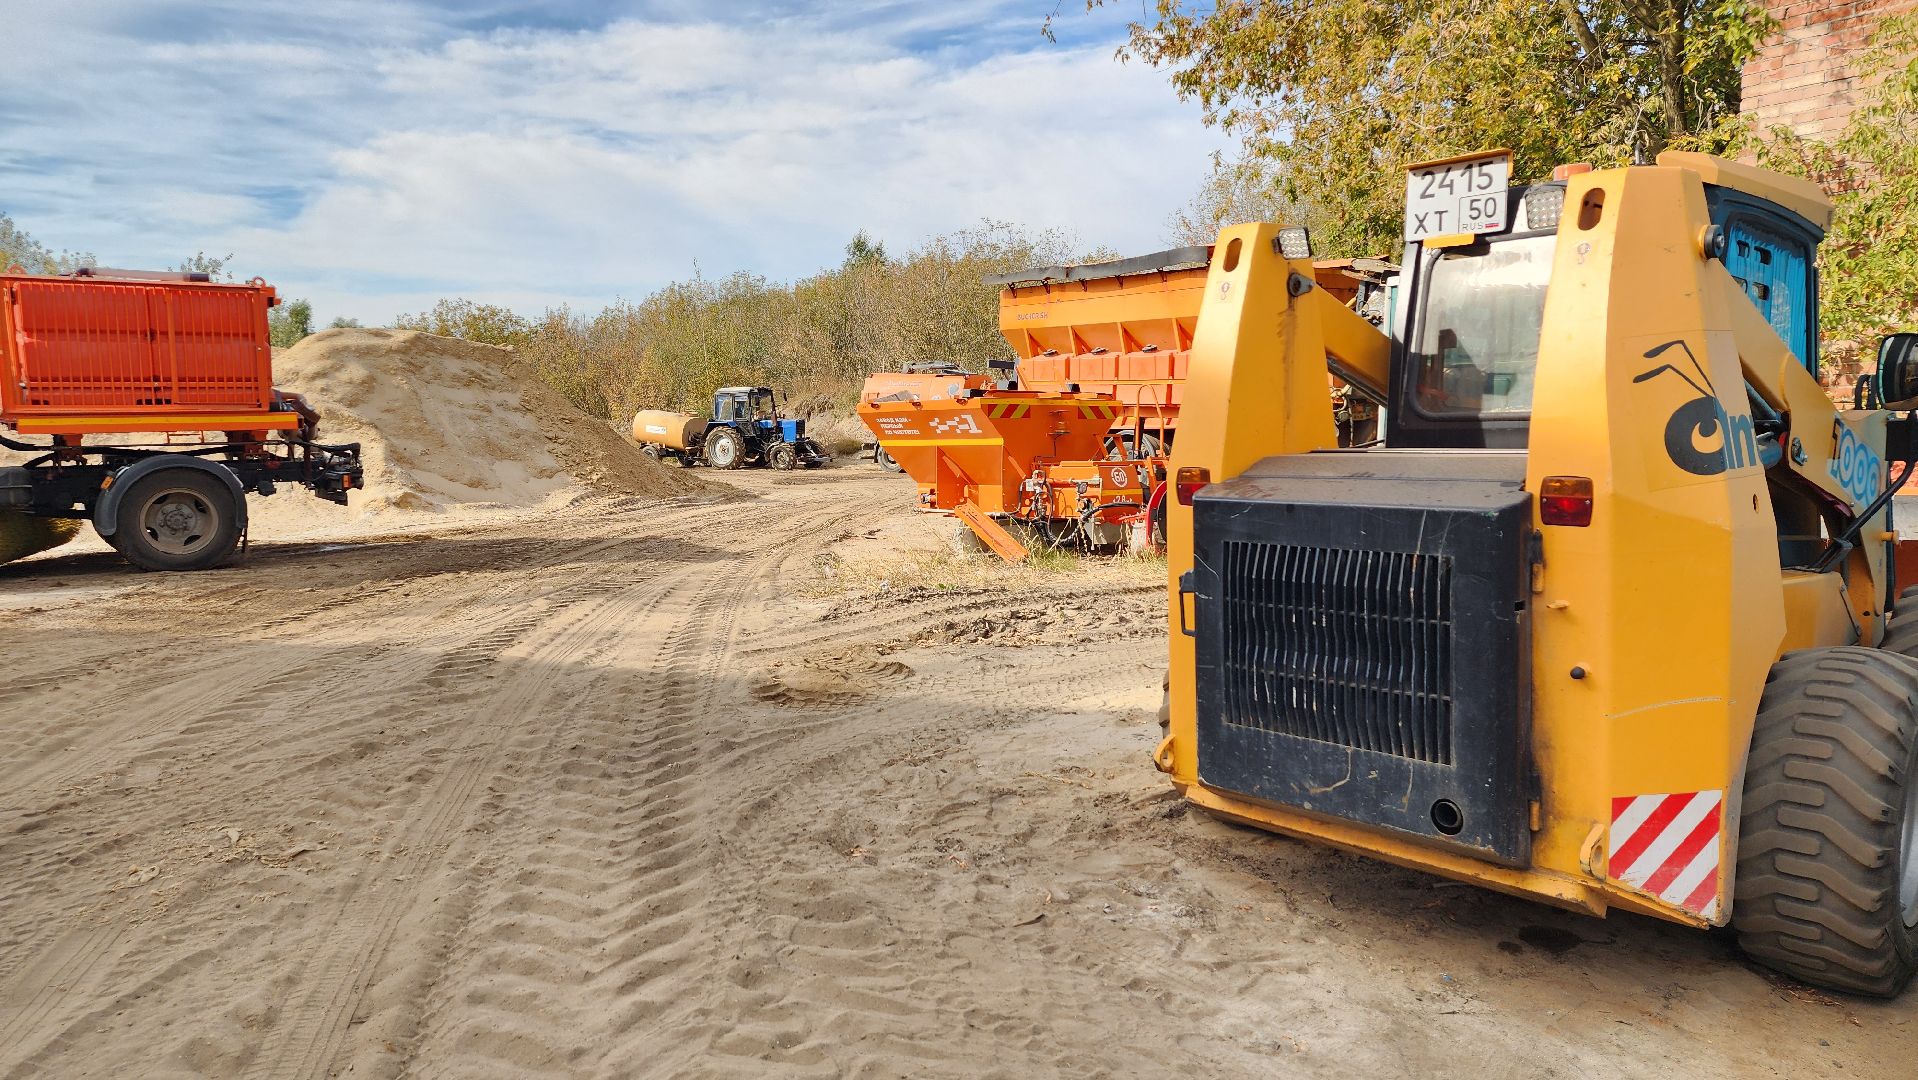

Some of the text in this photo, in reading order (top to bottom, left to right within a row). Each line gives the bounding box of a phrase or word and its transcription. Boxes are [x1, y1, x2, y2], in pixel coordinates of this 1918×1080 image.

[1419, 161, 1494, 200] 2415
[1468, 197, 1497, 220] 50
[1462, 222, 1484, 231] RUS
